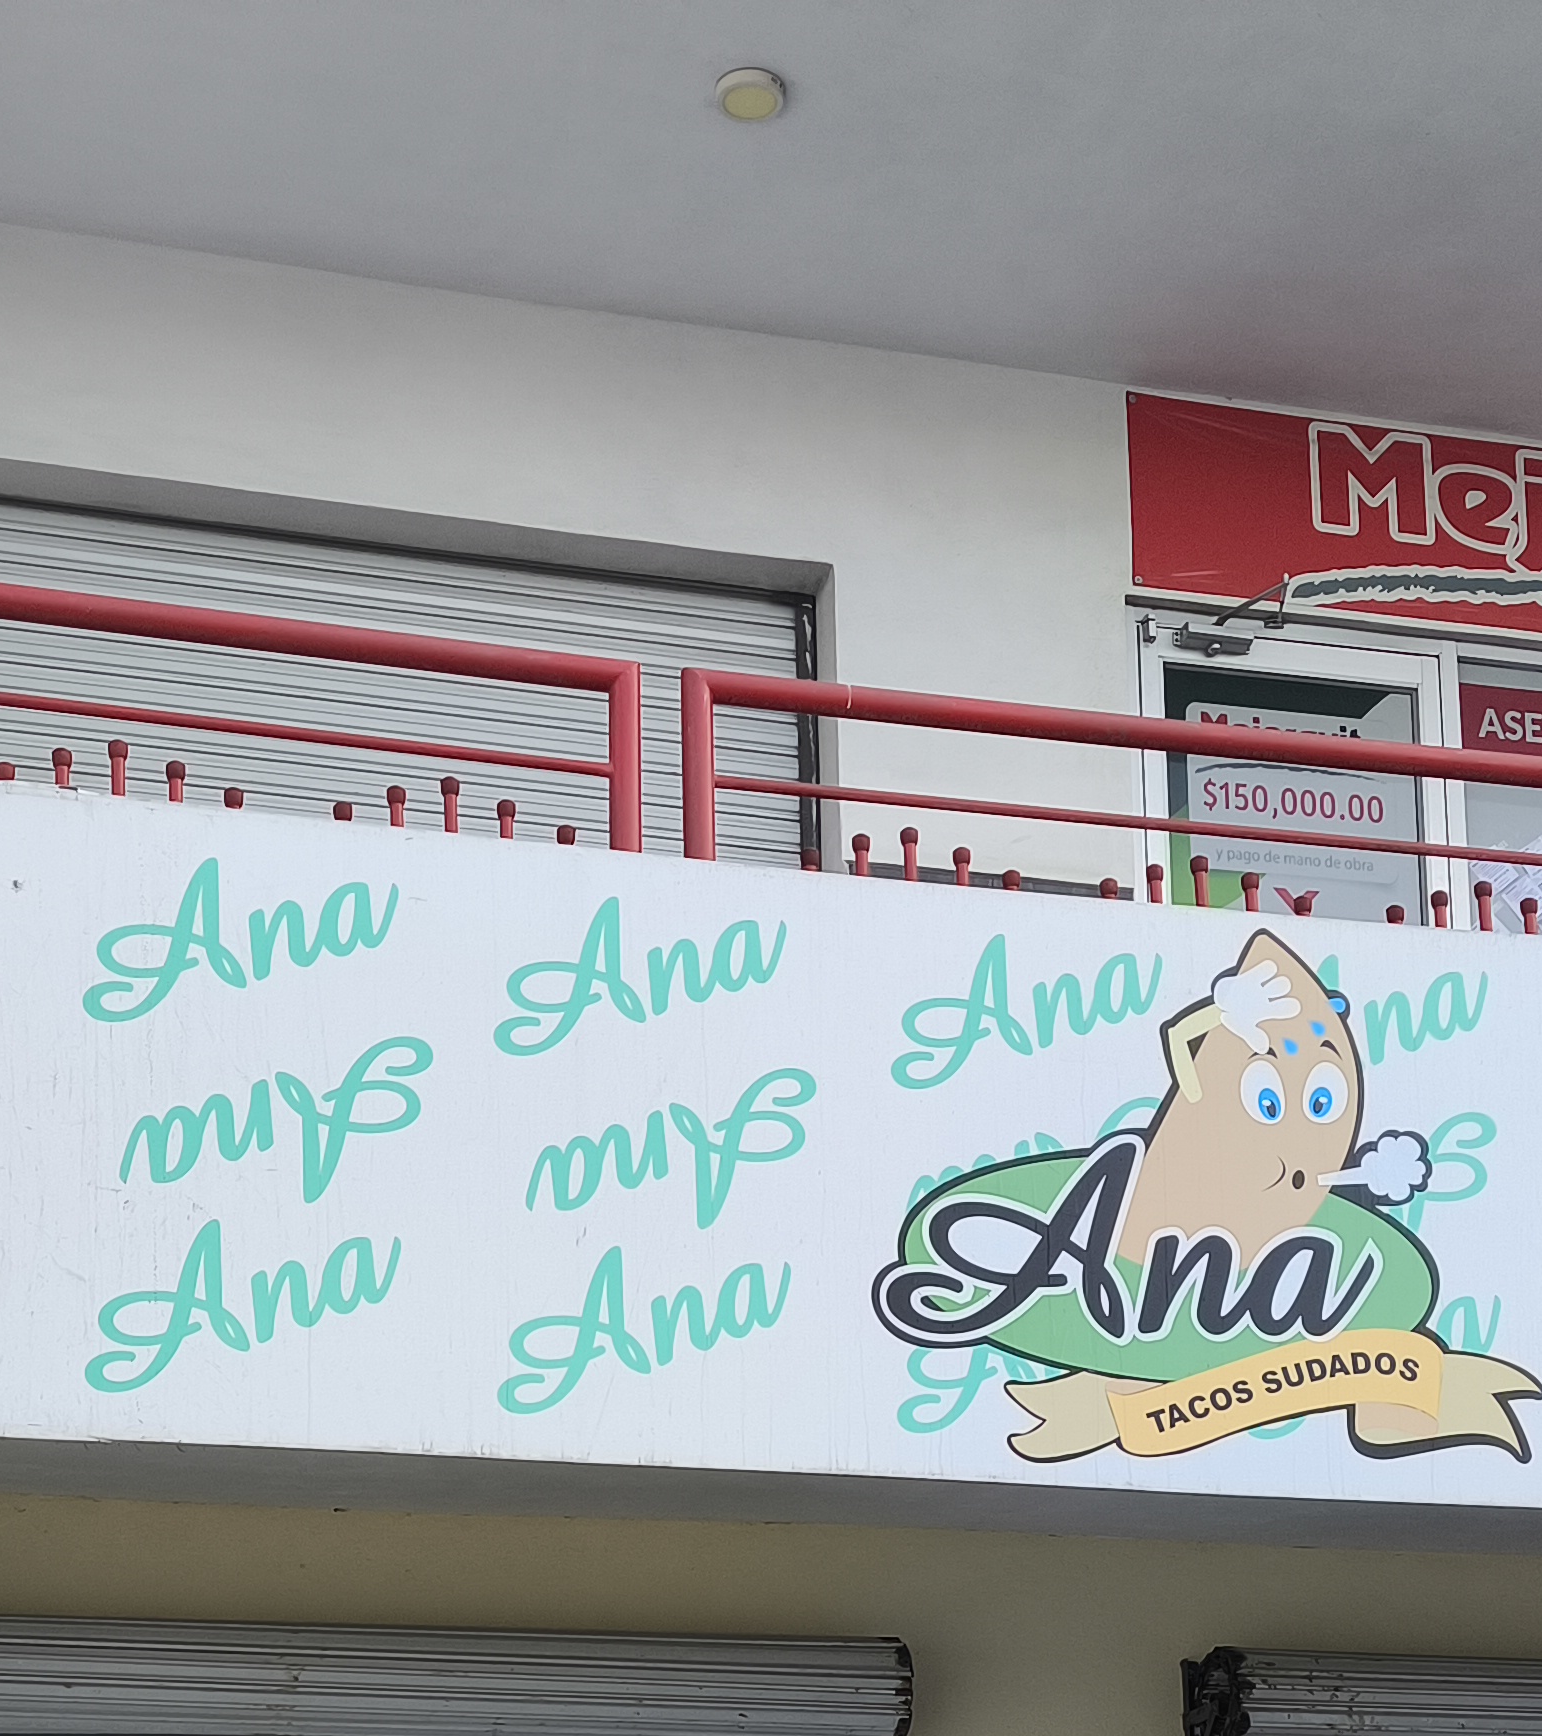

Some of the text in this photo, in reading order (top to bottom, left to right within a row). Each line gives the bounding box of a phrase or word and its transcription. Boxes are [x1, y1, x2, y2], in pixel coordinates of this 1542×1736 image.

[1203, 777, 1385, 824] $150,000.00
[1226, 849, 1260, 865] pago
[1263, 850, 1281, 864] de
[1283, 854, 1322, 868] mano
[1324, 855, 1341, 869] de
[1343, 857, 1374, 872] obra
[83, 858, 399, 1022] Ana
[495, 898, 787, 1056] Ana
[891, 935, 1162, 1089] Ana
[120, 1037, 433, 1203] Ana
[527, 1069, 817, 1229] Ana
[85, 1221, 401, 1393] Ana
[883, 1140, 1377, 1338] Ana
[498, 1247, 791, 1414] Ana
[1146, 1350, 1421, 1435] TACOS SUDADOS
